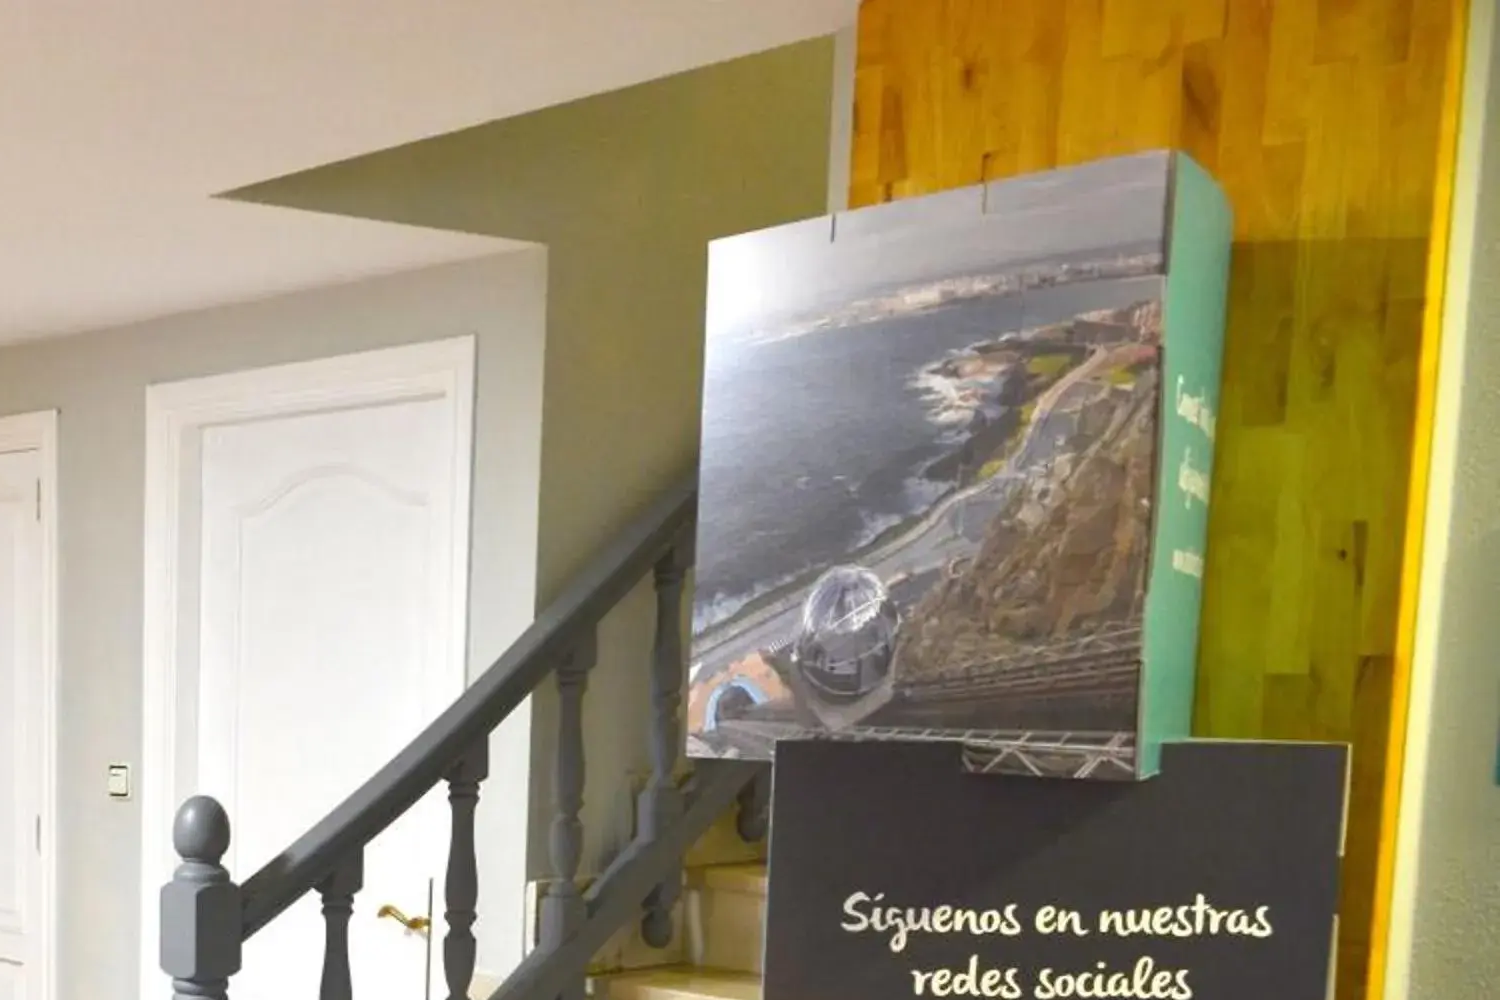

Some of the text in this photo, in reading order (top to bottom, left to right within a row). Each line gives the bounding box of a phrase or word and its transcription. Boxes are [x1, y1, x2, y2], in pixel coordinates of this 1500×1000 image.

[840, 891, 1273, 952] Síguenos en nuestras
[911, 954, 1193, 1000] redes sociales
